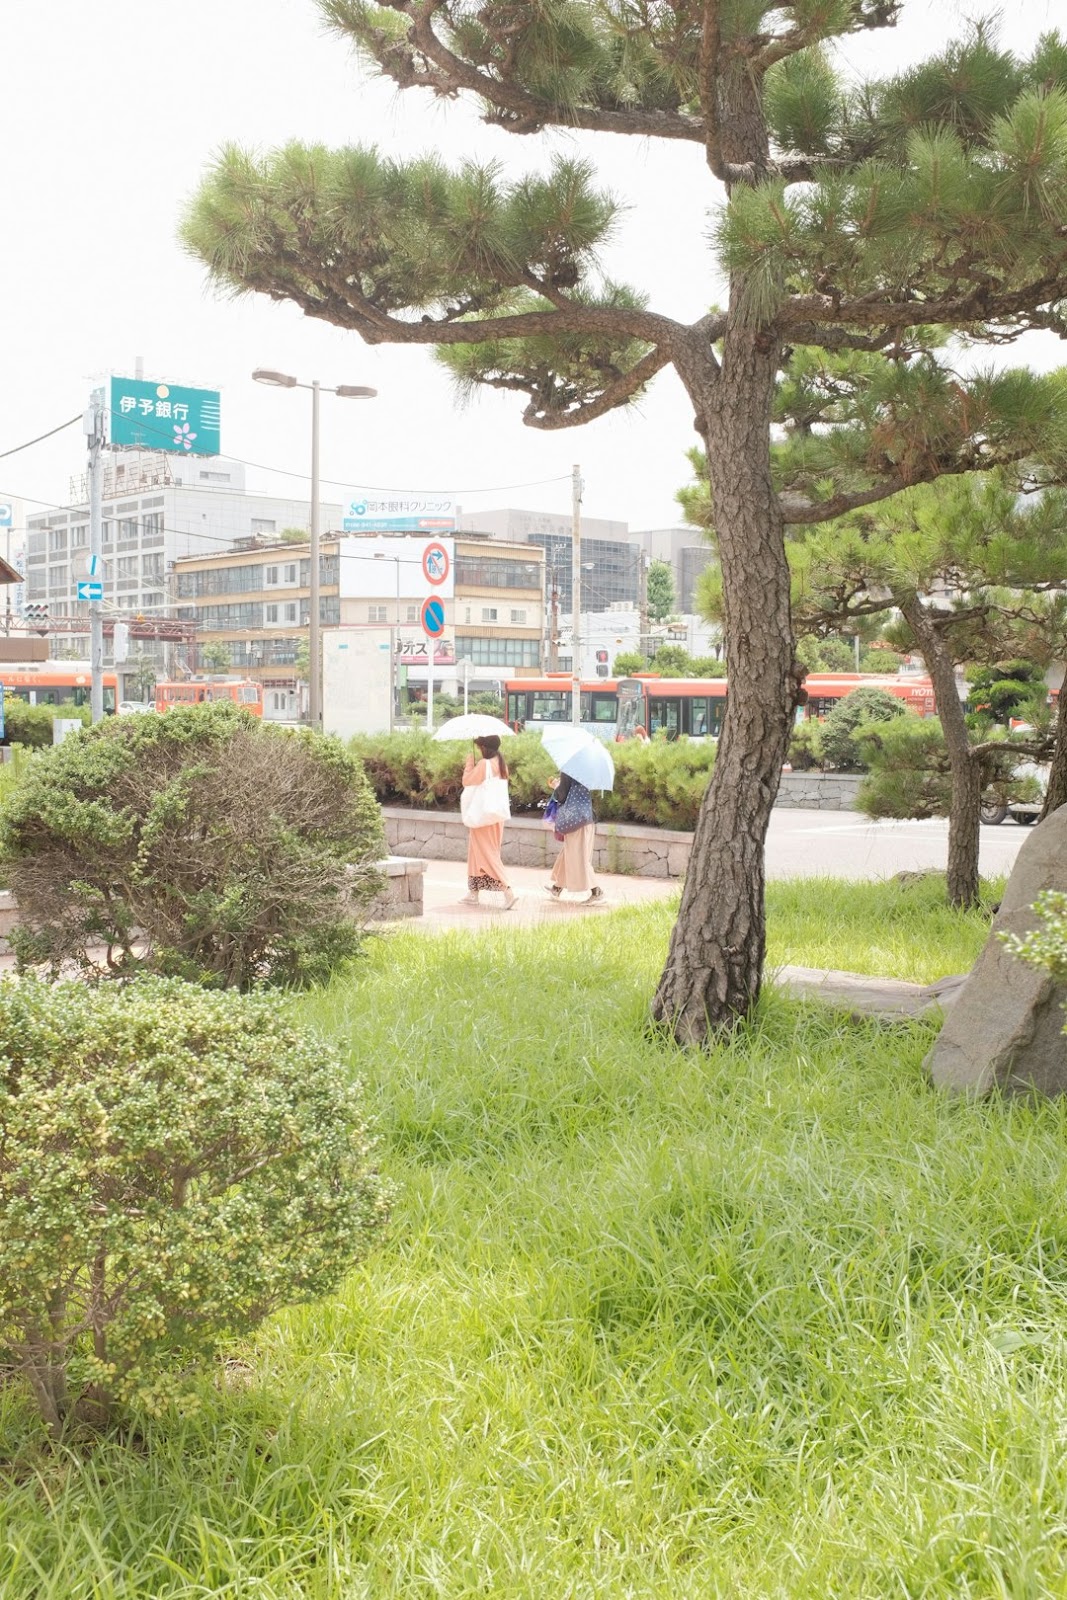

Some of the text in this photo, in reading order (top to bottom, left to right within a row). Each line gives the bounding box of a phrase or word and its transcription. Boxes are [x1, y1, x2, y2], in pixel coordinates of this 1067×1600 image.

[120, 396, 189, 421] 伊予銀行
[367, 501, 452, 513] 岡本眼科クリニック
